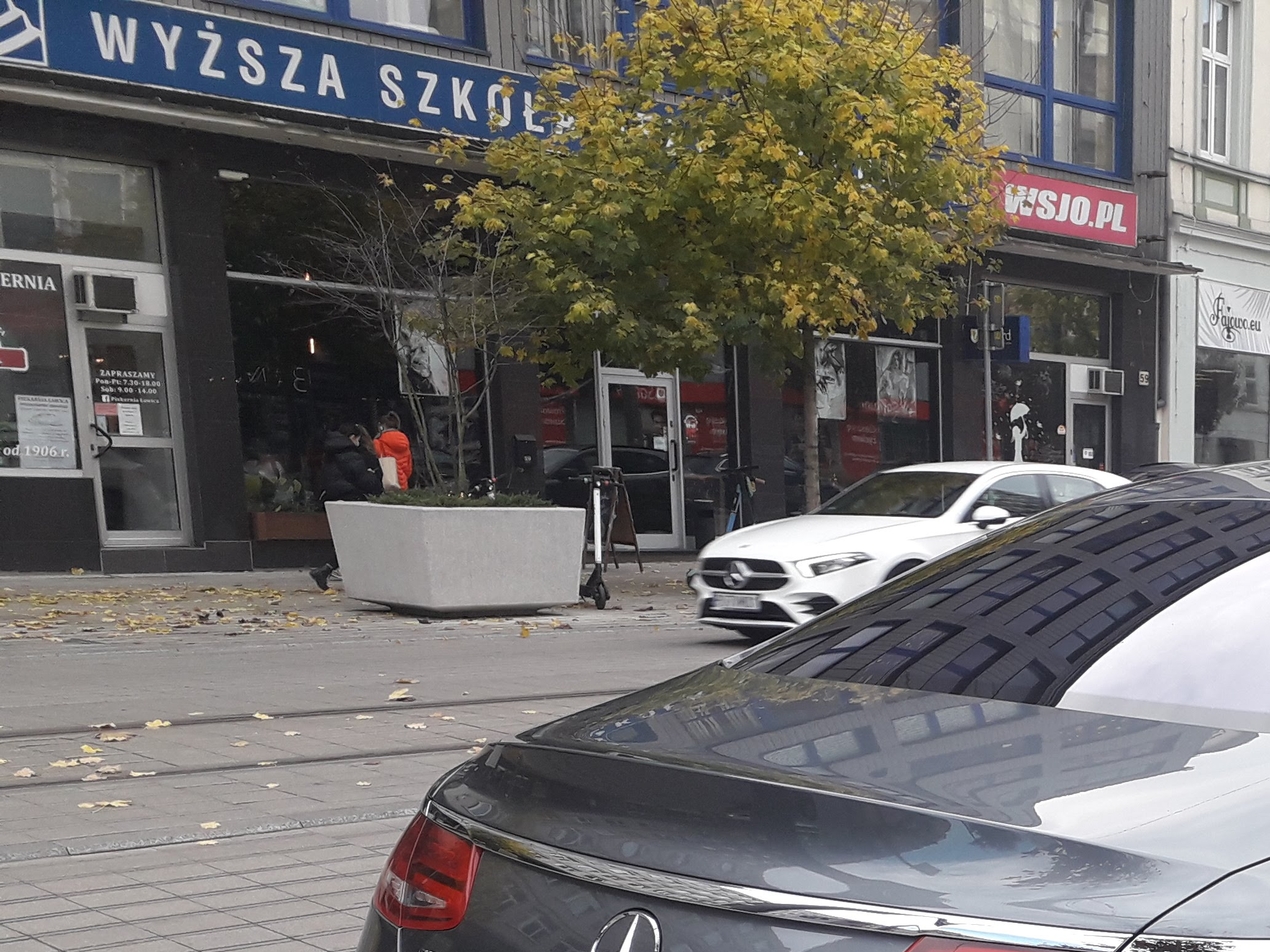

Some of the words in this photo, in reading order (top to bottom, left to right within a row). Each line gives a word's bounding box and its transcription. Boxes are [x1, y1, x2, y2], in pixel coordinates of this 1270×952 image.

[89, 10, 346, 100] WYŻSZA
[379, 63, 575, 135] SZKOŁ
[1004, 183, 1127, 233] WSJO.PL
[99, 369, 156, 379] ZAPRASZAMY
[1139, 373, 1149, 384] 59
[3, 444, 20, 456] od
[24, 445, 58, 457] 1906
[60, 448, 70, 458] r.
